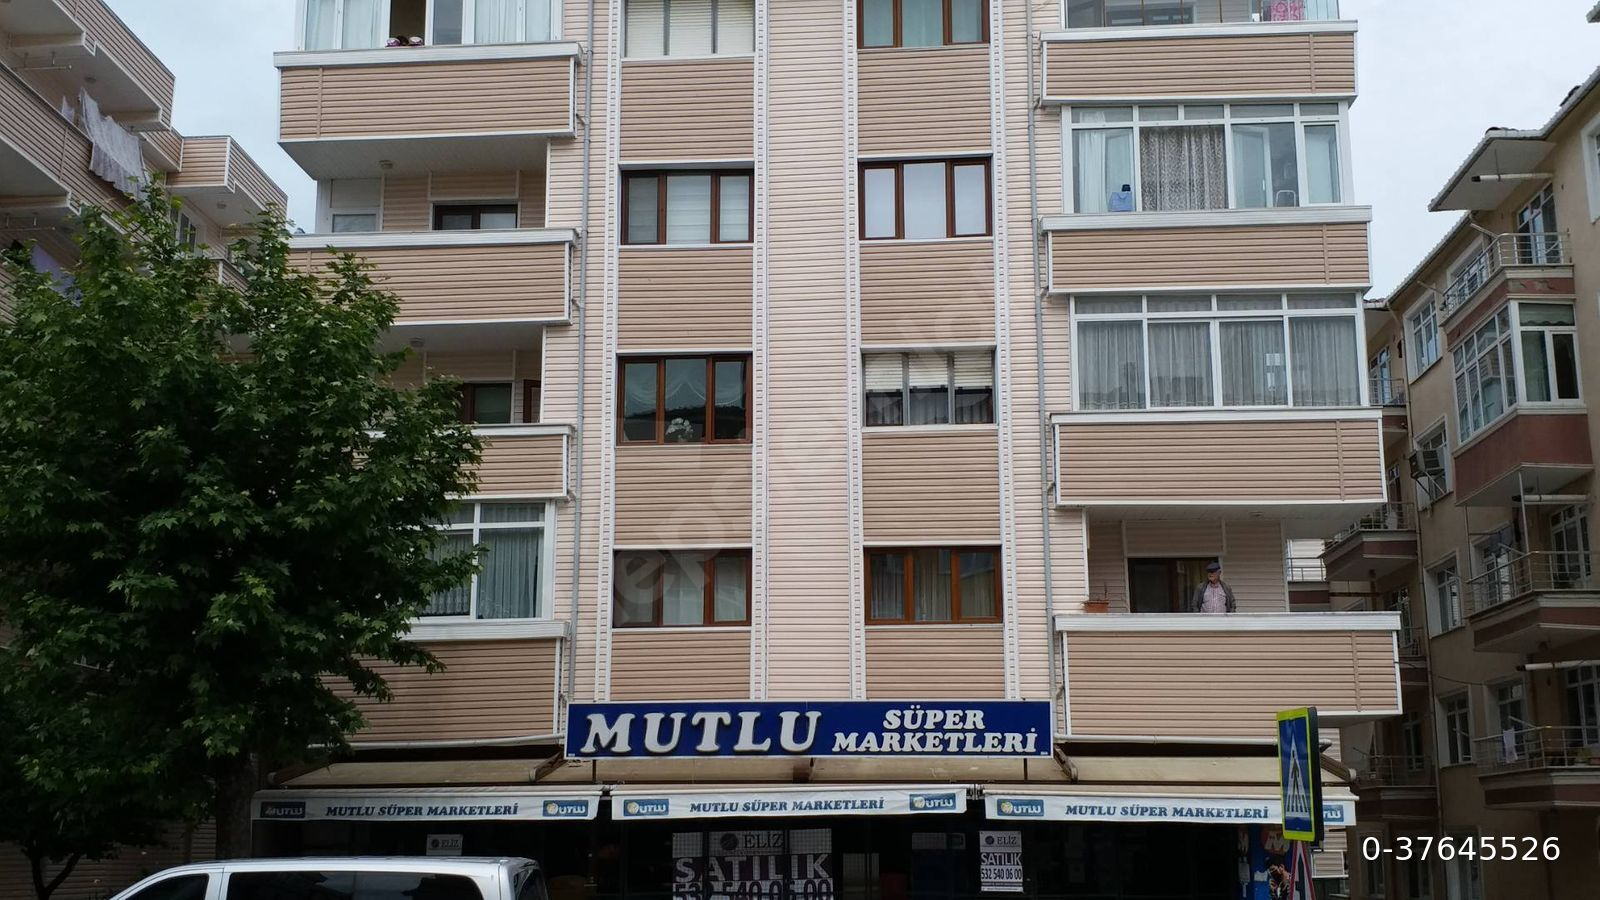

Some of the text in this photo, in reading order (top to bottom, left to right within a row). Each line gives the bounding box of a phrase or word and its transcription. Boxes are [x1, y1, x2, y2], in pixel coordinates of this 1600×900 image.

[882, 705, 986, 730] SÜPER
[579, 711, 822, 754] MUTLU
[832, 728, 1038, 752] MARKETLERİ
[325, 803, 519, 816] MUTLU SÜPER MARKETLERİ
[690, 796, 885, 813] MUTLU SÜPER MARKETLERİ
[1065, 803, 1269, 819] MUTLU SÜPER MARKETLERİ
[981, 852, 1022, 866] SATILIK
[675, 854, 830, 883] SATILIK
[981, 868, 992, 880] 532
[993, 868, 1005, 880] 540
[1014, 868, 1022, 880] 00
